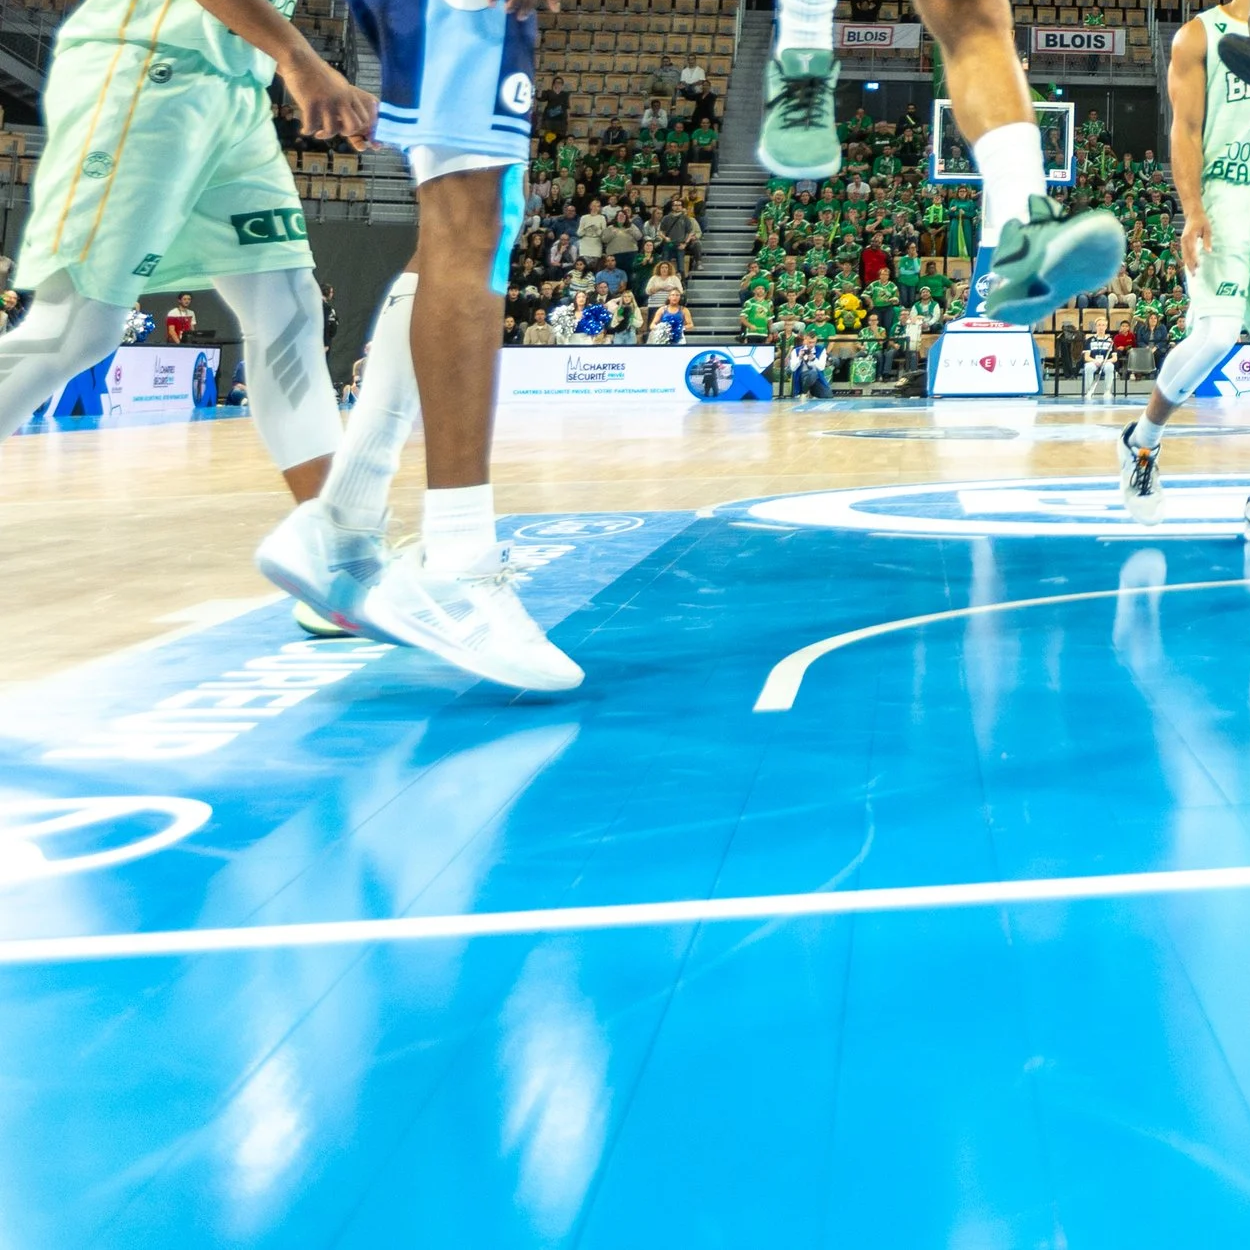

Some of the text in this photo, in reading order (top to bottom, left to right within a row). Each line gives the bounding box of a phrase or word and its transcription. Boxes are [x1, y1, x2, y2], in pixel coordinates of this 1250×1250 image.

[847, 31, 888, 43] BLOIS
[1045, 33, 1106, 49] BLOIS
[243, 213, 307, 239] CIC
[583, 363, 626, 371] CHARTRES
[943, 358, 1030, 368] SYNELVA
[568, 371, 606, 381] SÉCURITÉ
